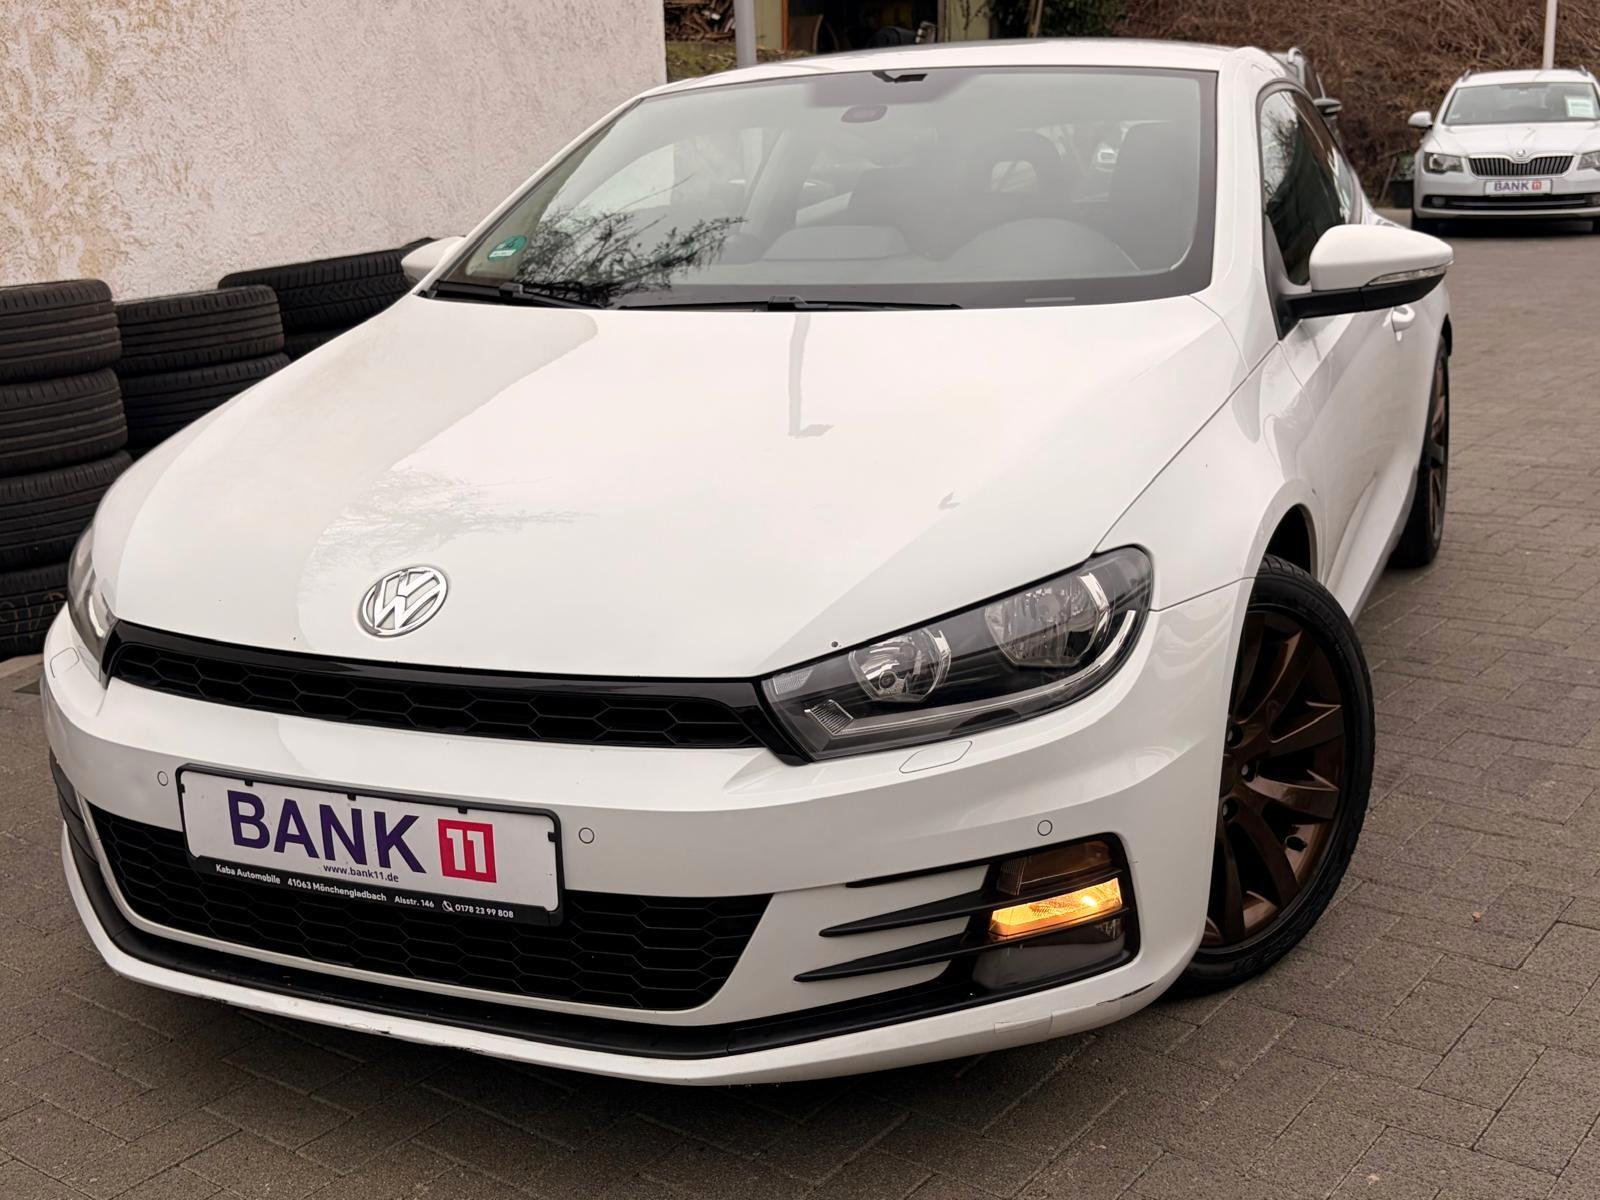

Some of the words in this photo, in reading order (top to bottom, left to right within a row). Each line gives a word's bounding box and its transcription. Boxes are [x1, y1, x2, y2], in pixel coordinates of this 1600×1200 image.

[1494, 181, 1529, 191] BANK
[227, 790, 427, 874] BANK
[444, 826, 489, 876] 11
[215, 863, 236, 876] Kaba
[236, 868, 281, 885] Automobile
[287, 877, 312, 890] 41063
[312, 882, 387, 902] Mönchengladbach
[394, 895, 420, 907] Alsstr.
[420, 899, 435, 909] 146
[455, 903, 474, 914] 0178
[475, 906, 485, 915] 23
[486, 907, 496, 916] 99
[498, 909, 514, 919] 808
[323, 864, 399, 883] www.bank11.de
